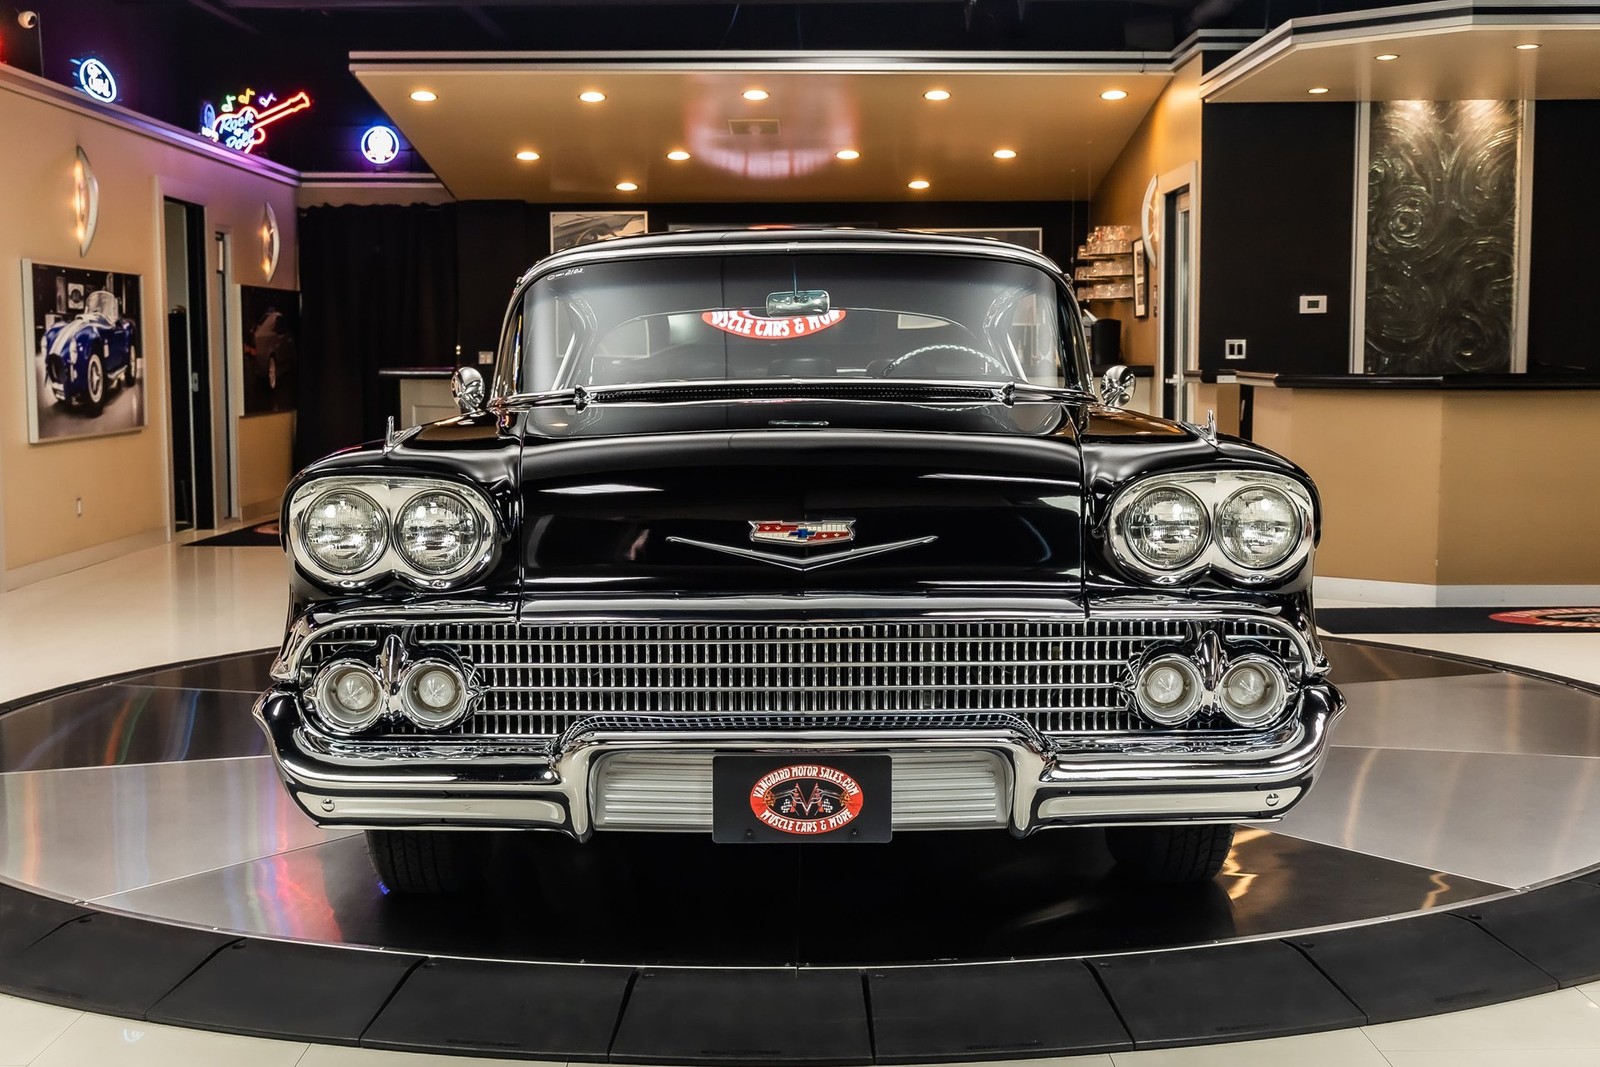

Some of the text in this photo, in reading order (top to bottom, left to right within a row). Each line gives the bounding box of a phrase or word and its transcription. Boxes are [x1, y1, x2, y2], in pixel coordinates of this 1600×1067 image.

[711, 310, 752, 335] USCLE
[755, 319, 790, 336] CARS
[794, 318, 805, 334] &
[753, 765, 860, 798] VANGUARD MOTOR SALES.COM
[760, 808, 853, 833] MUSCLE CARS & MORE
